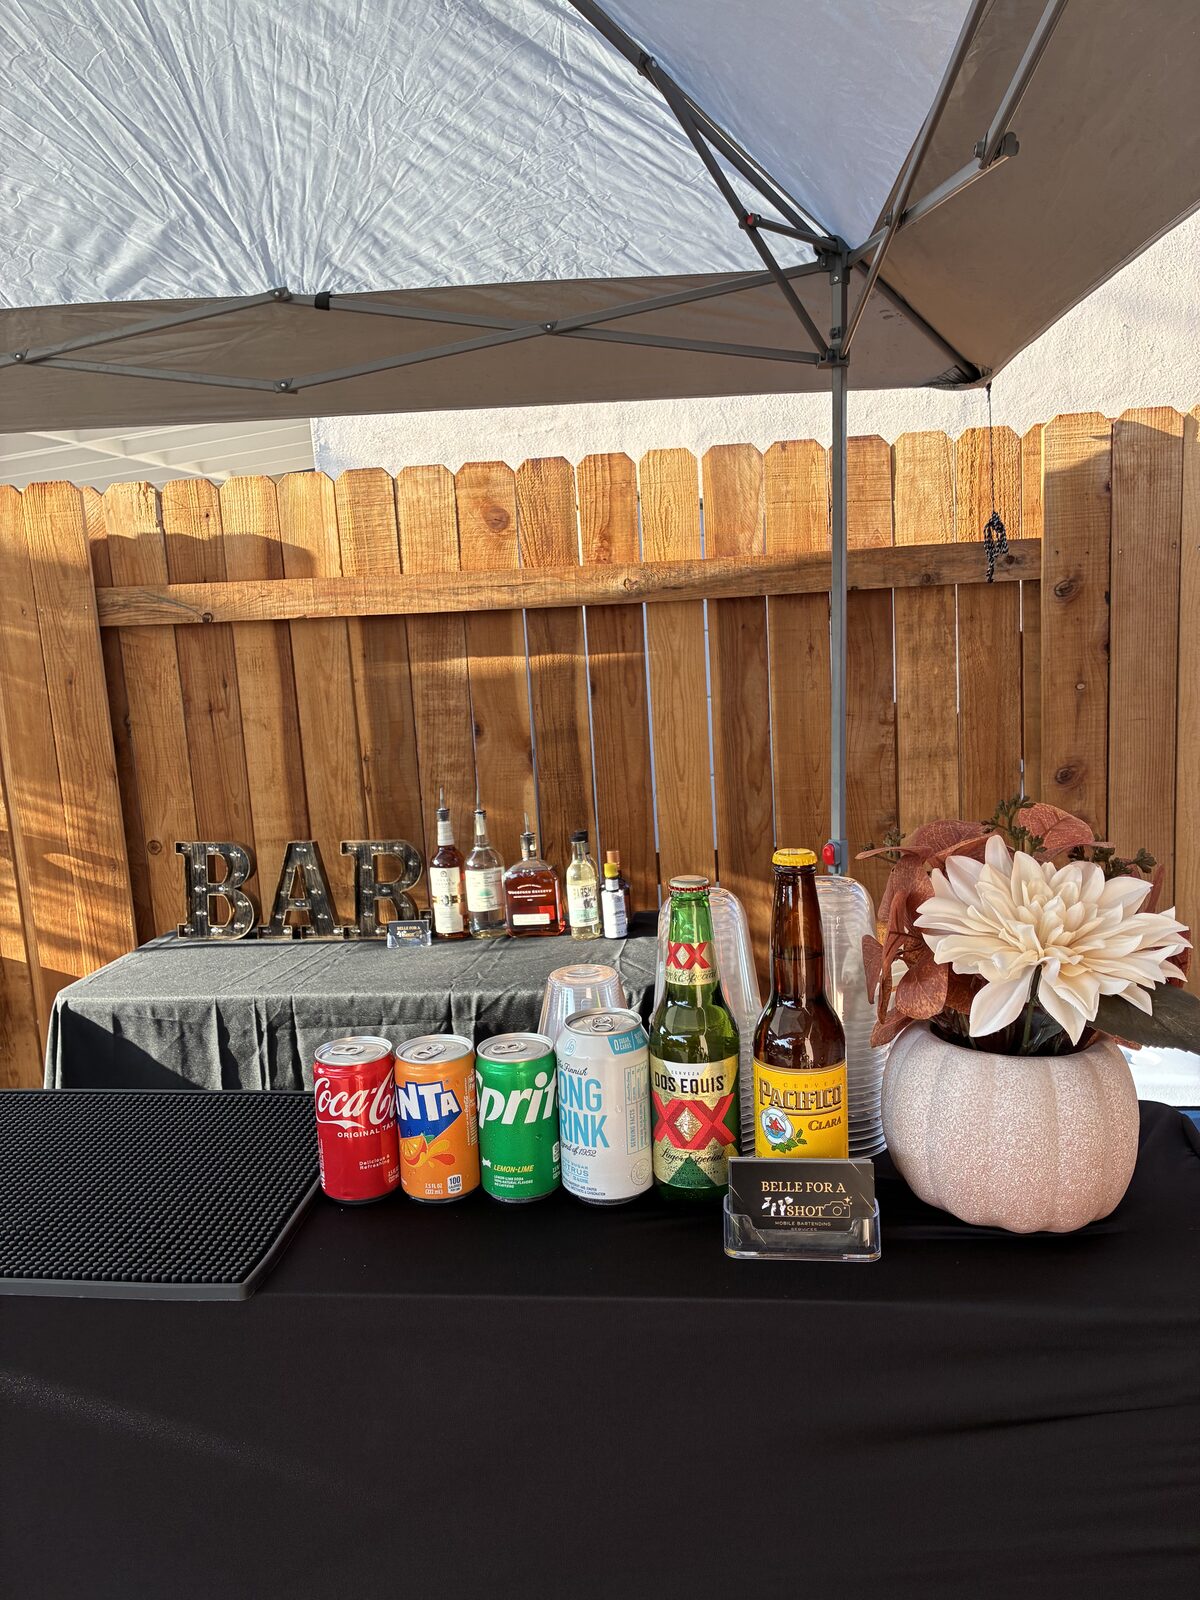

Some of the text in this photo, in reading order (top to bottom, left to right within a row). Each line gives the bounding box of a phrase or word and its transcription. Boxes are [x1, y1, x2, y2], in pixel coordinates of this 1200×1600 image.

[175, 839, 432, 939] BAR
[666, 939, 712, 970] XX
[564, 1062, 588, 1076] Finnish
[559, 1070, 603, 1113] ONG
[654, 1071, 676, 1092] DOS
[680, 1075, 724, 1095] EQUIS
[314, 1067, 397, 1129] Coca-Col
[397, 1083, 459, 1121] NTA
[476, 1068, 558, 1129] prit
[759, 1077, 842, 1111] PACIFICO
[337, 1119, 396, 1140] ORIGINAL TAST
[560, 1104, 610, 1148] RINK
[652, 1090, 737, 1151] XX
[807, 1116, 842, 1131] CLARA
[359, 1155, 385, 1167] Delicious
[579, 1148, 597, 1158] 1952
[660, 1148, 684, 1165] Lager
[359, 1159, 391, 1171] Refreshing
[493, 1164, 535, 1173] LEMON-LIME
[449, 1176, 461, 1185] 100
[761, 1181, 846, 1194] BELLE FOR A
[786, 1205, 825, 1217] SHOT
